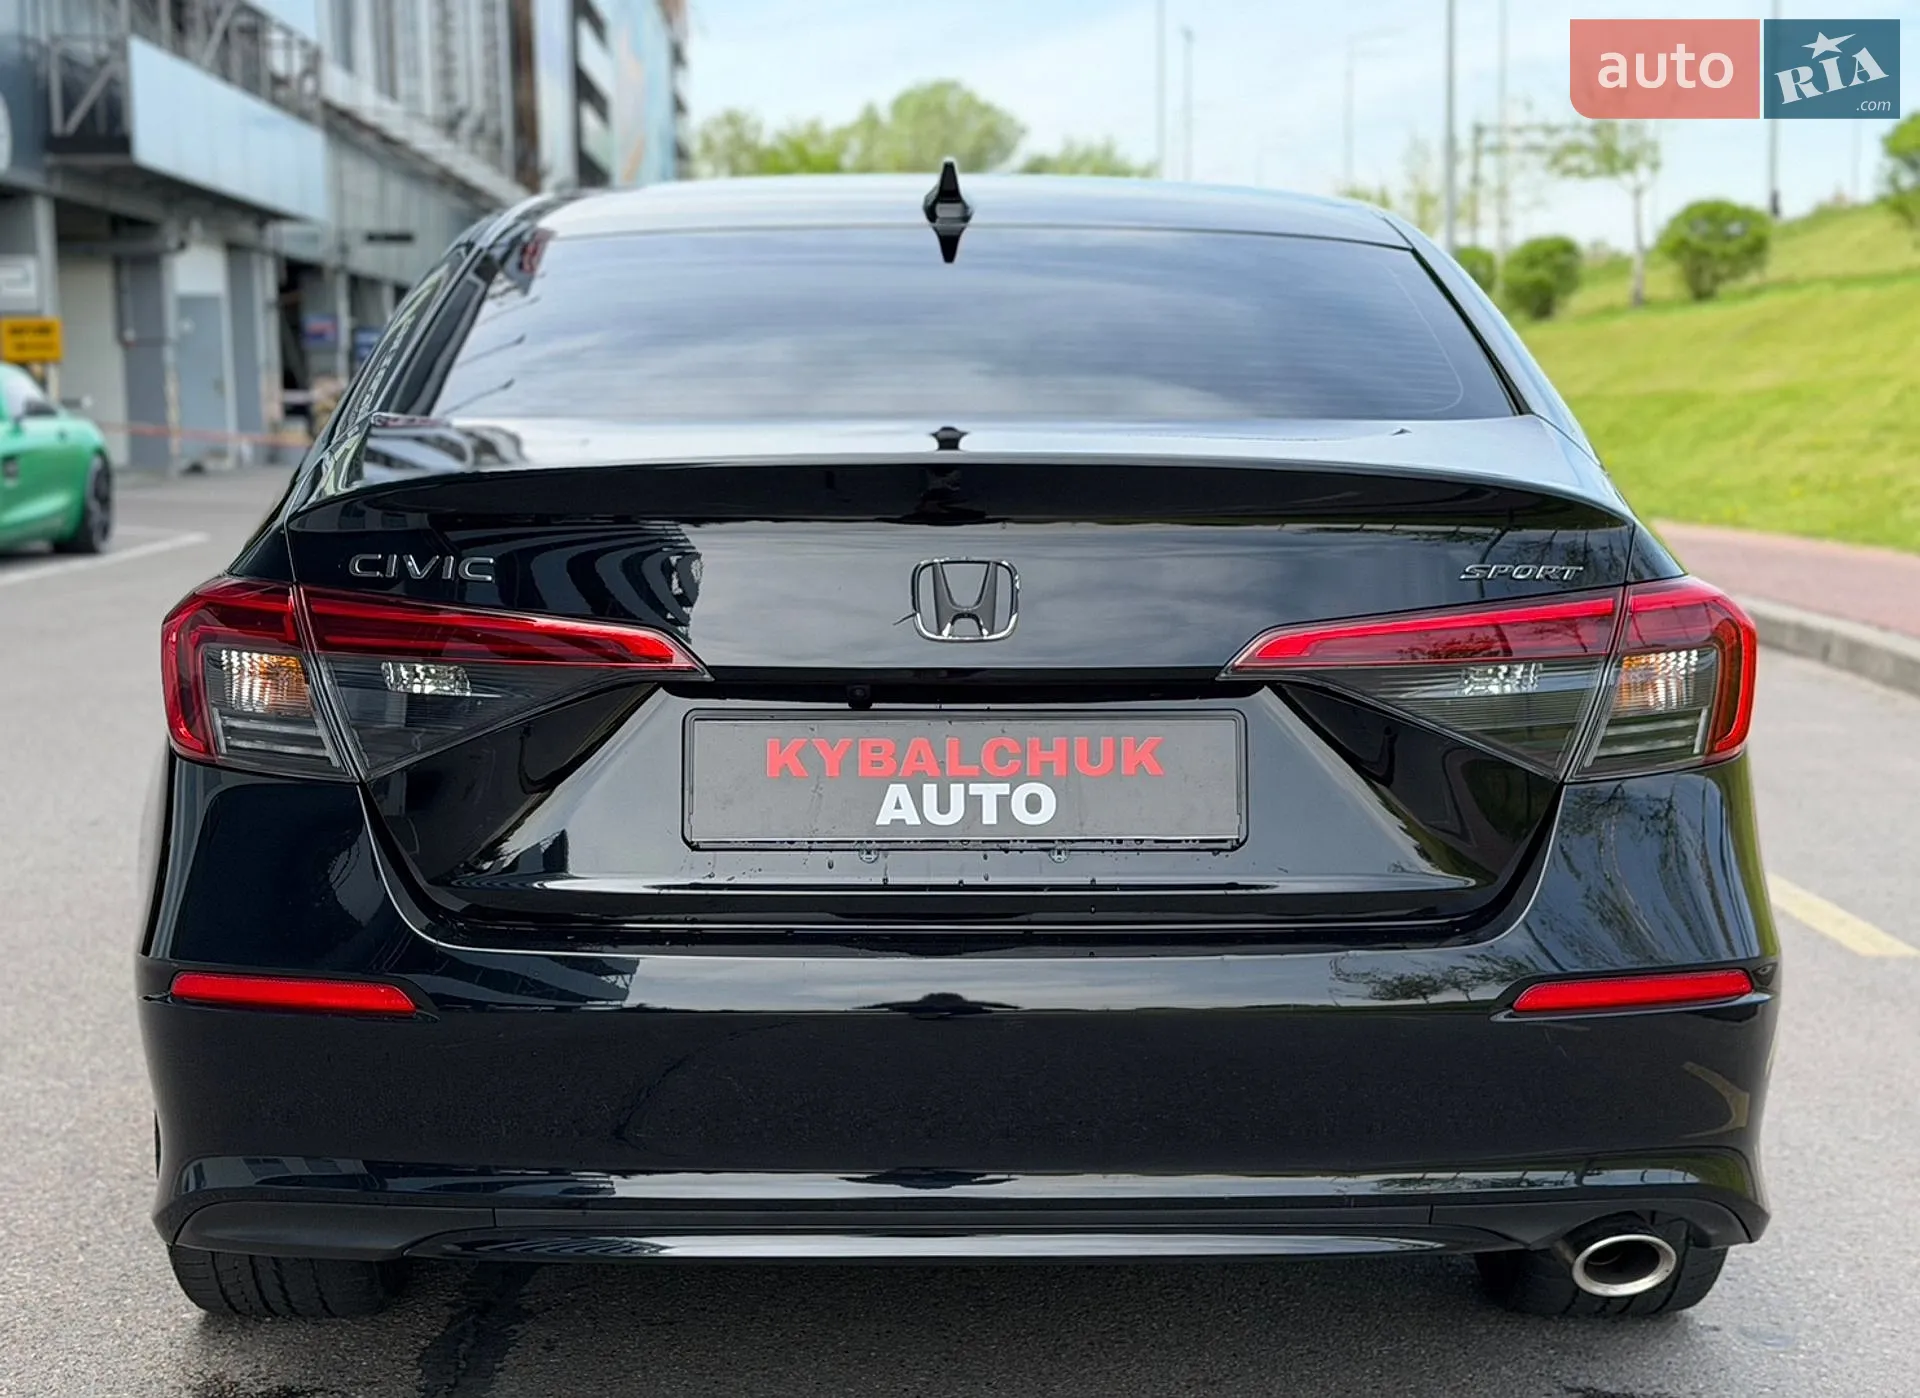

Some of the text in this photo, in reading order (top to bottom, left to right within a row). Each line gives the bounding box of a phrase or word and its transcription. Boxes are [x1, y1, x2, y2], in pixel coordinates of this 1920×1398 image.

[349, 554, 495, 581] CIVIC
[1459, 564, 1584, 580] SPORT
[765, 736, 1165, 778] KYBALCHUK
[875, 782, 1057, 826] AUTO
